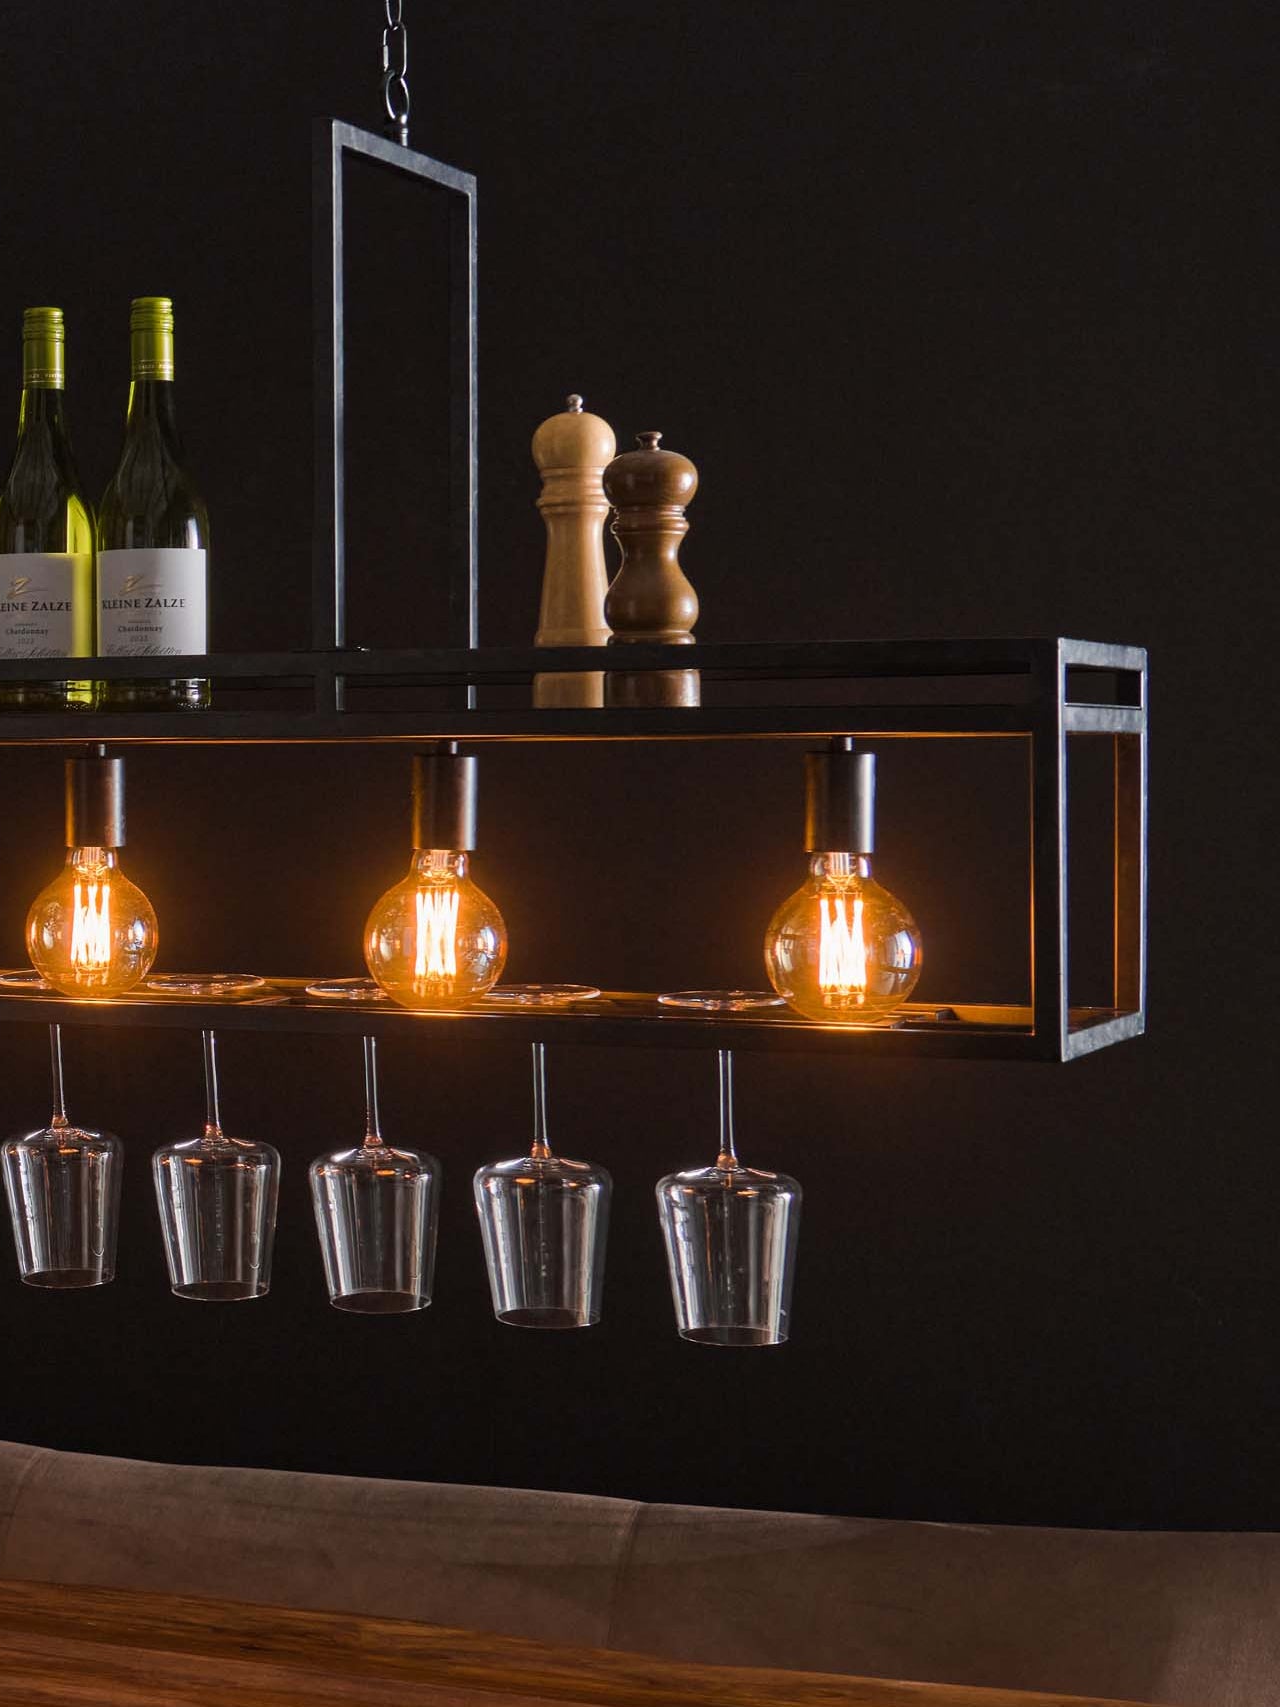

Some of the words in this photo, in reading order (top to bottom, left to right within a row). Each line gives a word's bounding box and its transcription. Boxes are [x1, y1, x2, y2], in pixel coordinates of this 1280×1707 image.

[31, 601, 73, 612] ZALZE
[102, 599, 141, 609] KLEINE
[144, 598, 186, 609] ZALZE
[5, 627, 49, 637] Chardonnay
[117, 625, 163, 633] Chardonnay
